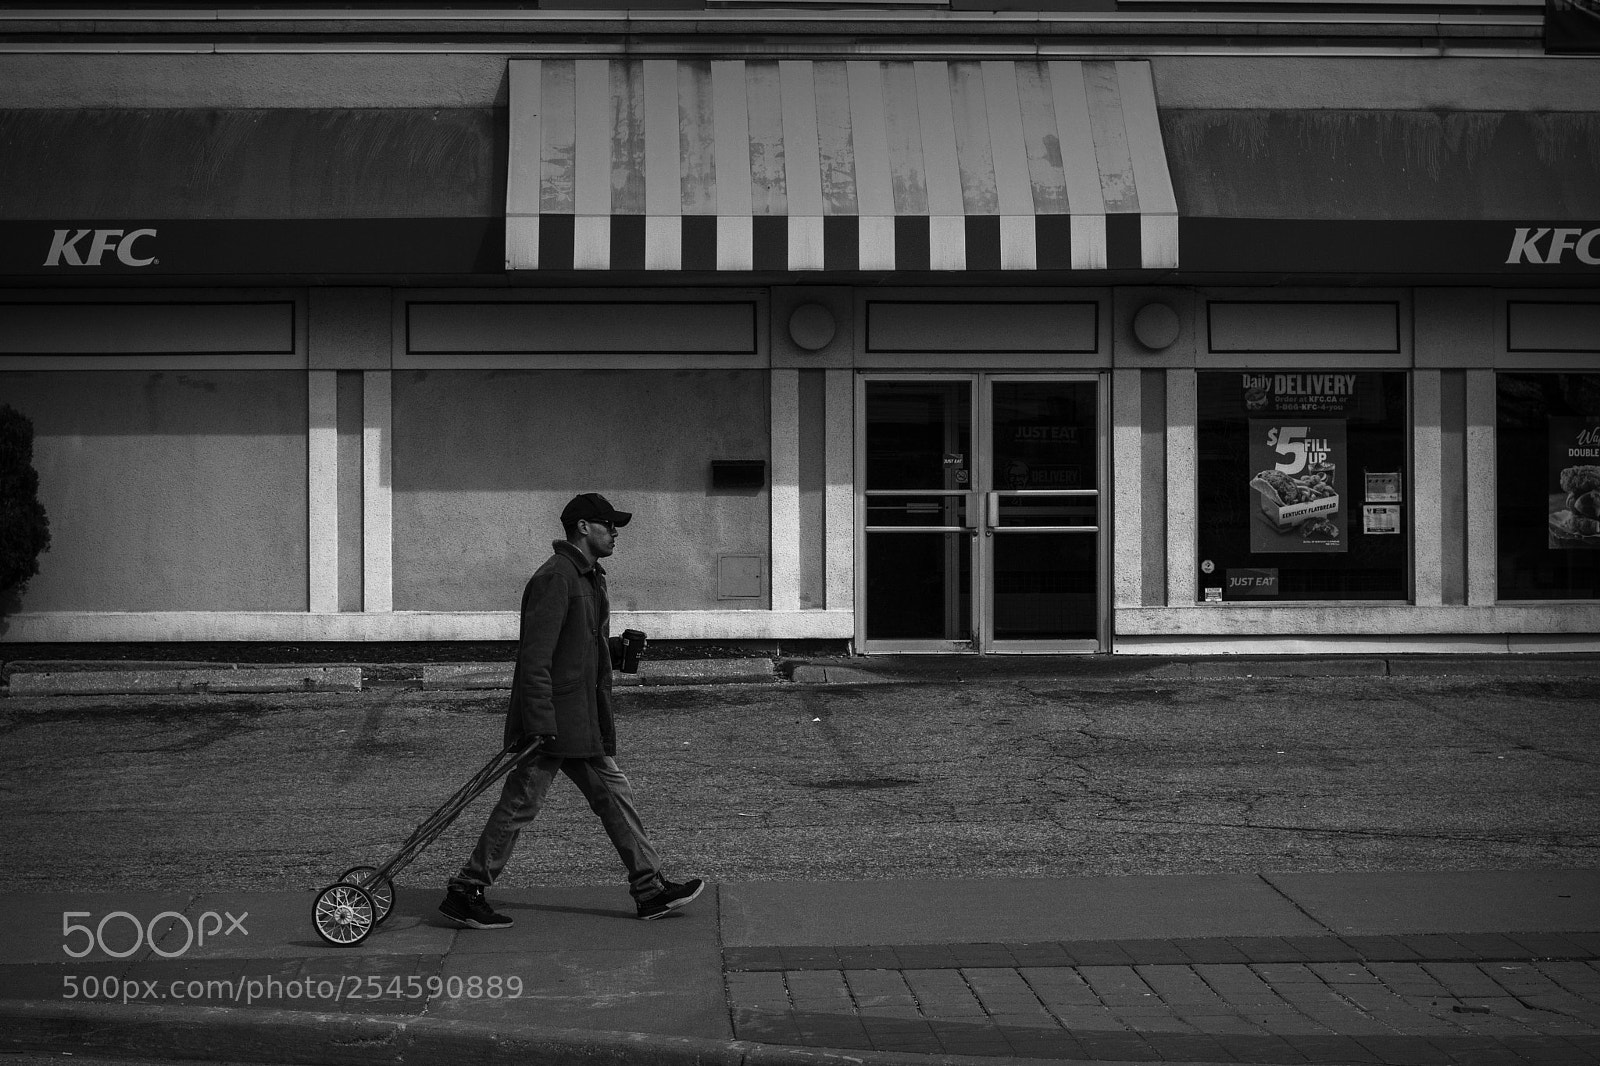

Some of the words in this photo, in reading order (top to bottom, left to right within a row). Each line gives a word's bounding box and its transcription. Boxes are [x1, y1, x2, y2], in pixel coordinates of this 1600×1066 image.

[43, 228, 158, 267] KFC
[1242, 373, 1273, 393] Daily
[1274, 374, 1356, 395] DELIVERY
[1015, 426, 1048, 440] JUST
[1051, 426, 1077, 440] EAT
[1304, 439, 1331, 453] FILL
[1568, 448, 1600, 457] DOUBLE
[1308, 452, 1327, 465] UP
[1032, 469, 1078, 484] DELIVERY
[1282, 509, 1308, 519] KENTUCKY
[1308, 502, 1336, 514] FLATBREAD
[1230, 577, 1254, 587] JUST
[1256, 577, 1275, 586] EAT
